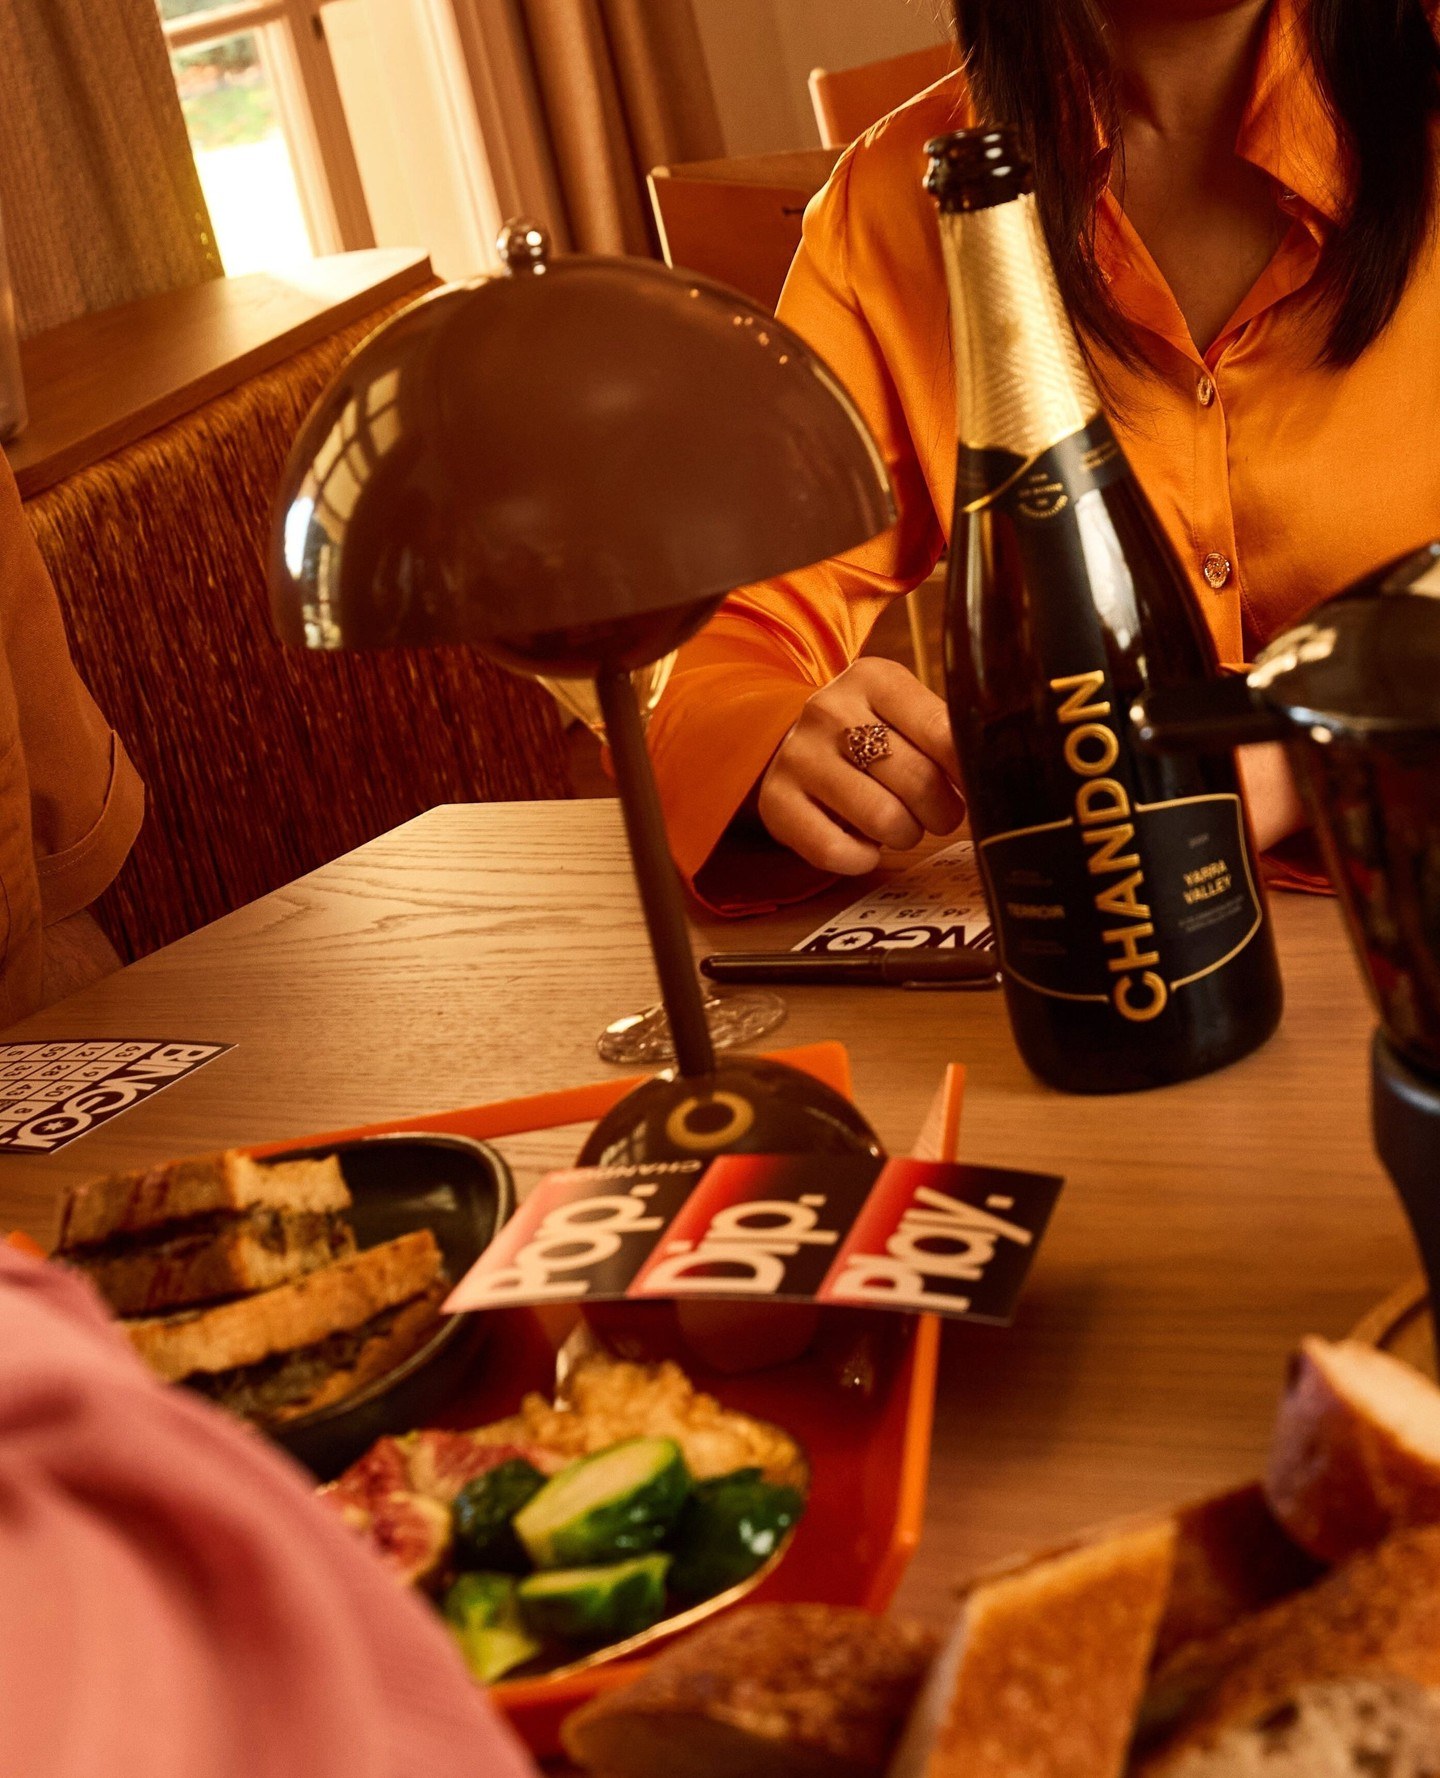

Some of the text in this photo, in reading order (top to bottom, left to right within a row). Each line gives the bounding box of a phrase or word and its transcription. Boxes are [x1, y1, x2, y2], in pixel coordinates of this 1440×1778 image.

[1051, 669, 1168, 1022] CHANDON
[1183, 860, 1228, 887] YARRA
[1183, 874, 1231, 904] VALLEY
[859, 909, 876, 919] 3
[896, 909, 927, 919] 25
[75, 1046, 105, 1057] 12
[115, 1046, 141, 1057] 63
[82, 1067, 110, 1077] 19
[6, 1084, 32, 1096] 43
[45, 1085, 75, 1097] 50
[458, 1183, 664, 1302] Pop.
[644, 1194, 838, 1294] Dip.
[831, 1185, 1033, 1312] Play.
